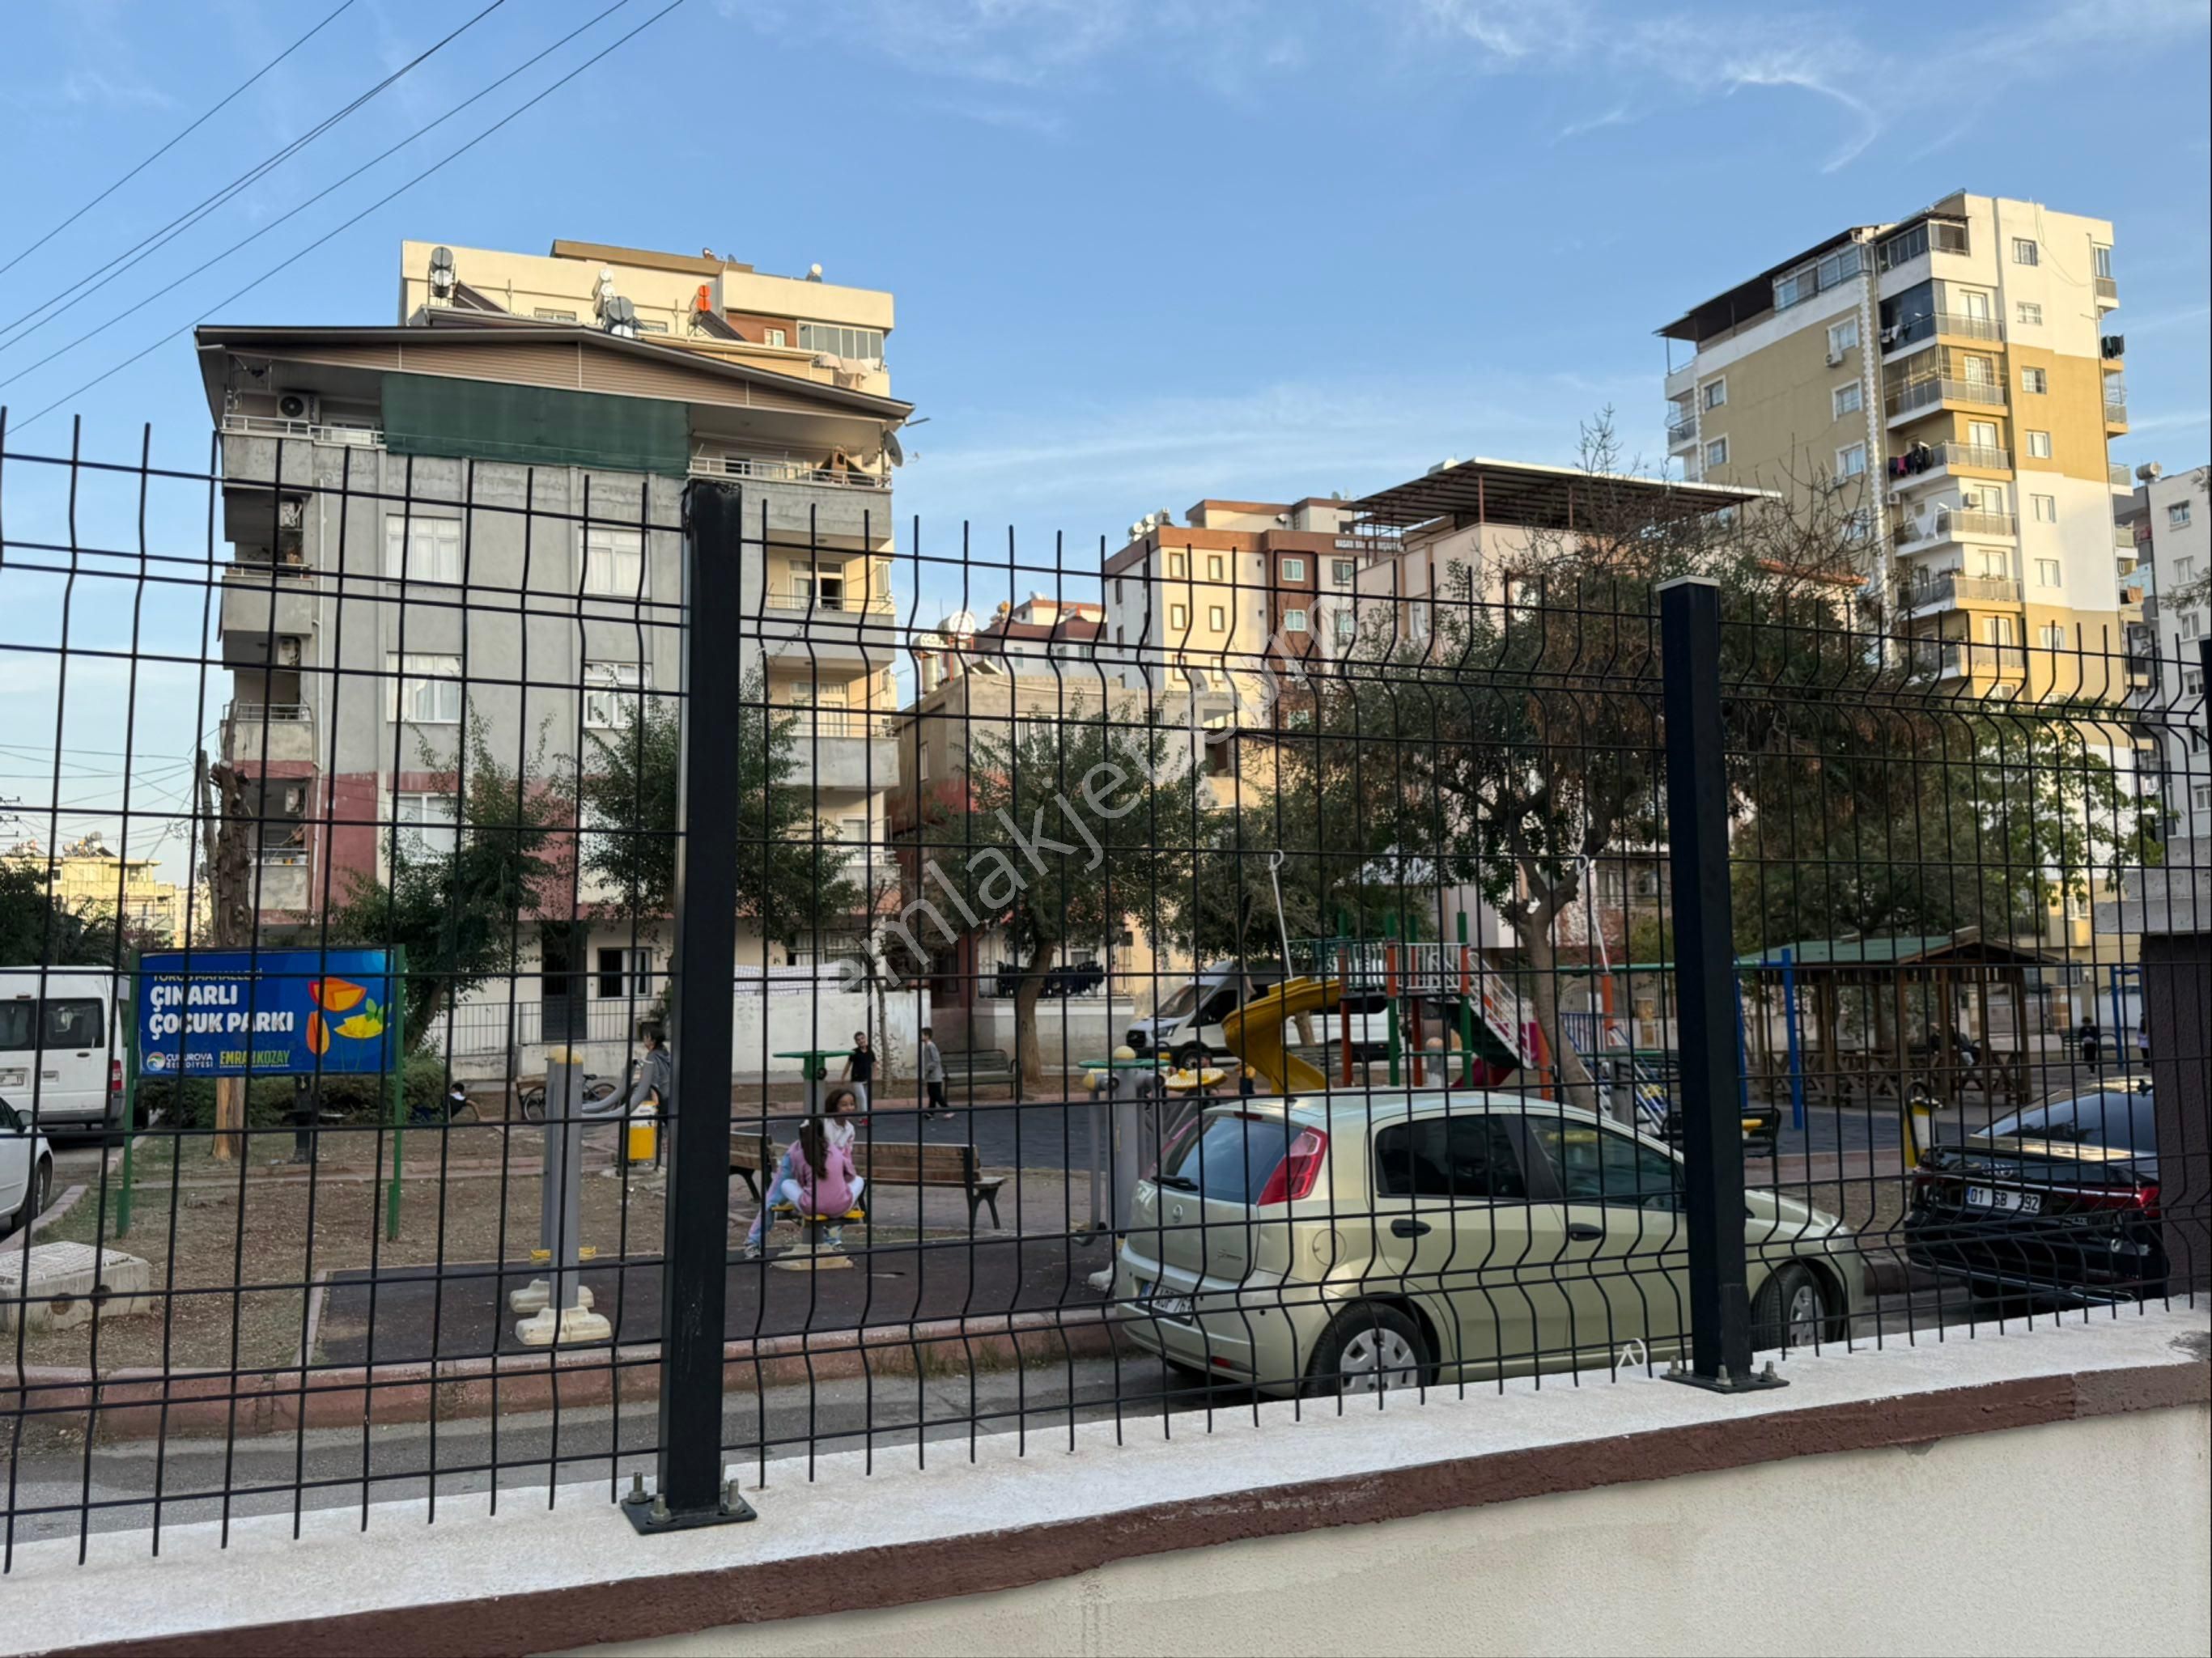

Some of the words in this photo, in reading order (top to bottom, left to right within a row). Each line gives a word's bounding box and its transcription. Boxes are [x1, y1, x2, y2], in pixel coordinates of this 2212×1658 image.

[150, 985, 238, 1012] ÇINARLI
[149, 1013, 223, 1041] ÇOCUK
[227, 1011, 294, 1033] PARKI
[1970, 1188, 1984, 1203] 01
[2018, 1194, 2039, 1211] 92
